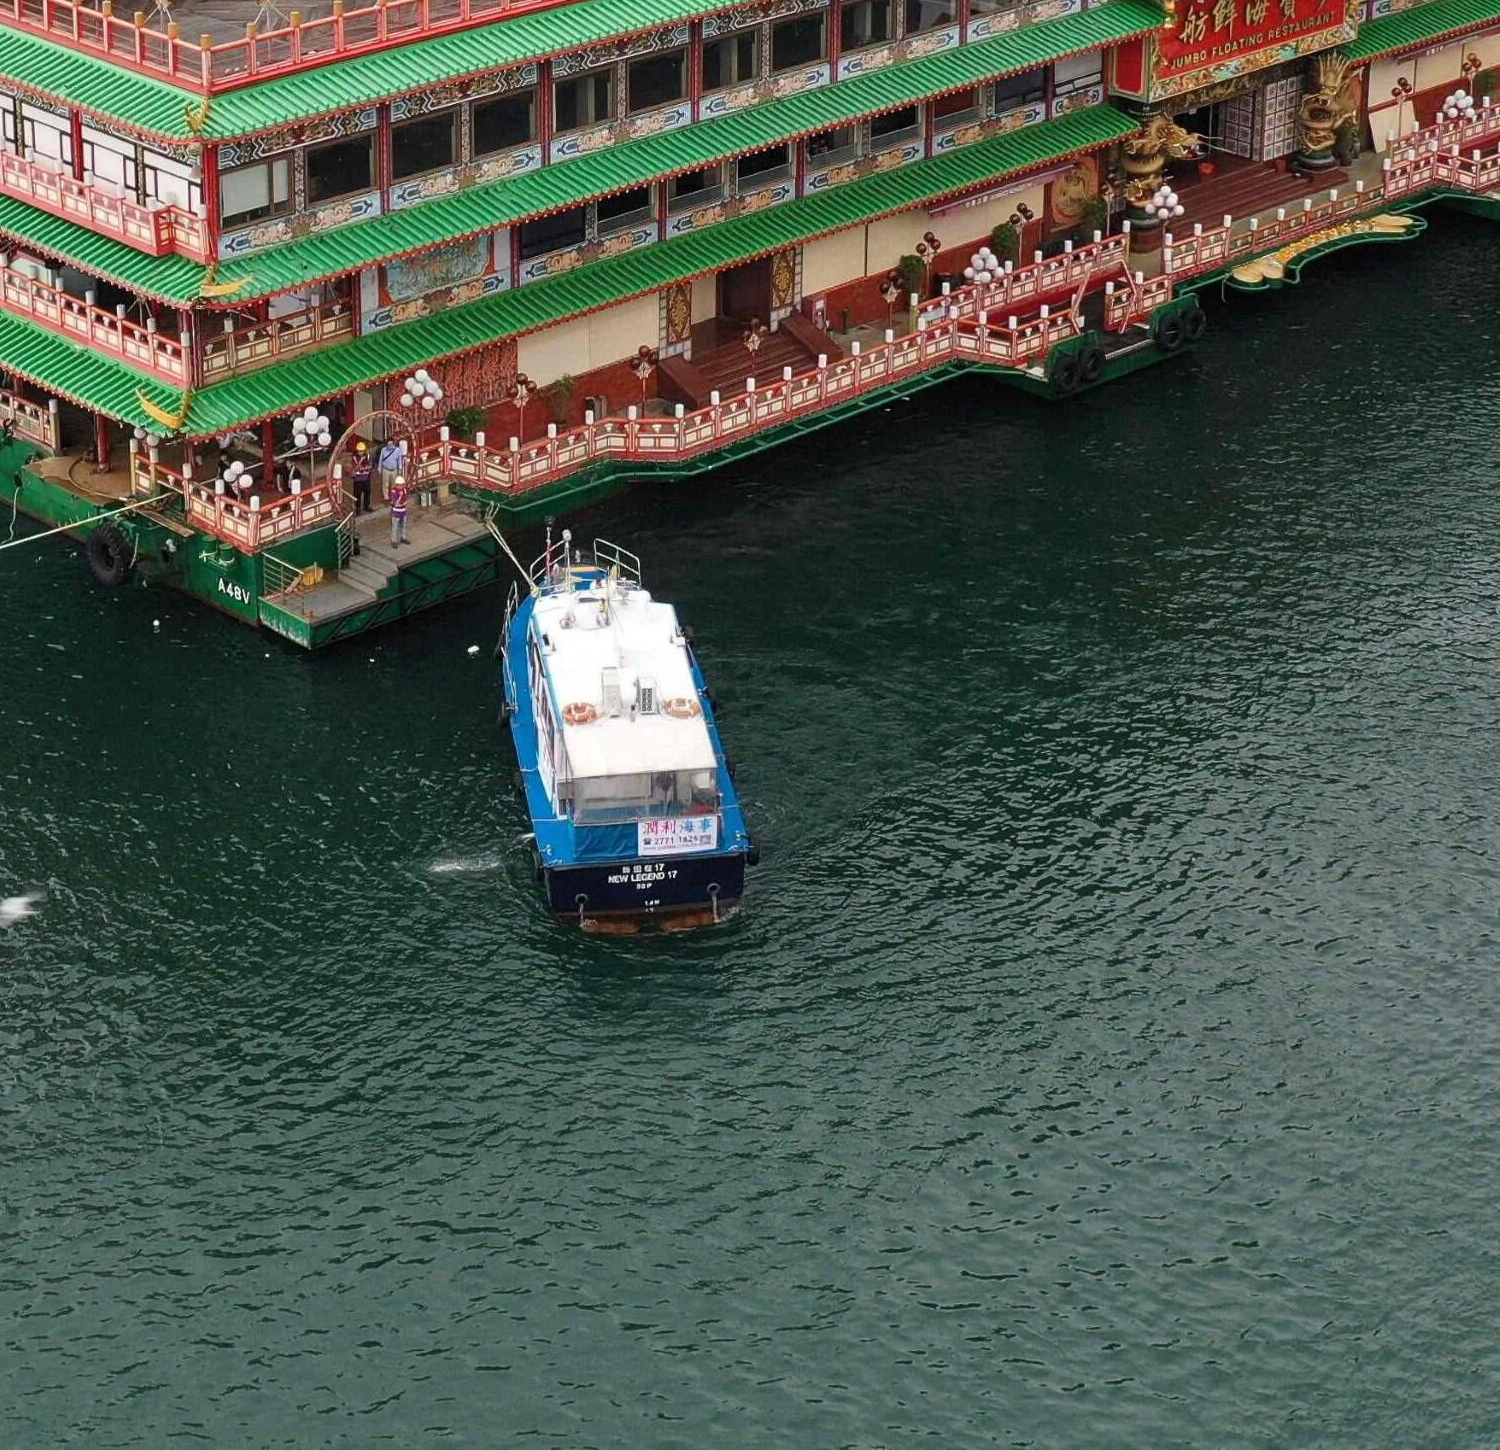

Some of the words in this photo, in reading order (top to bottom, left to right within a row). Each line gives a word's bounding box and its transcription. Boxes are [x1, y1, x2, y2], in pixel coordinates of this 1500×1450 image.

[1171, 52, 1207, 70] JUMBO
[1212, 33, 1264, 57] FLOATING
[1268, 10, 1336, 41] RESTAURANT
[608, 874, 628, 884] NEW
[631, 872, 665, 882] LEGEND
[667, 870, 678, 879] 17
